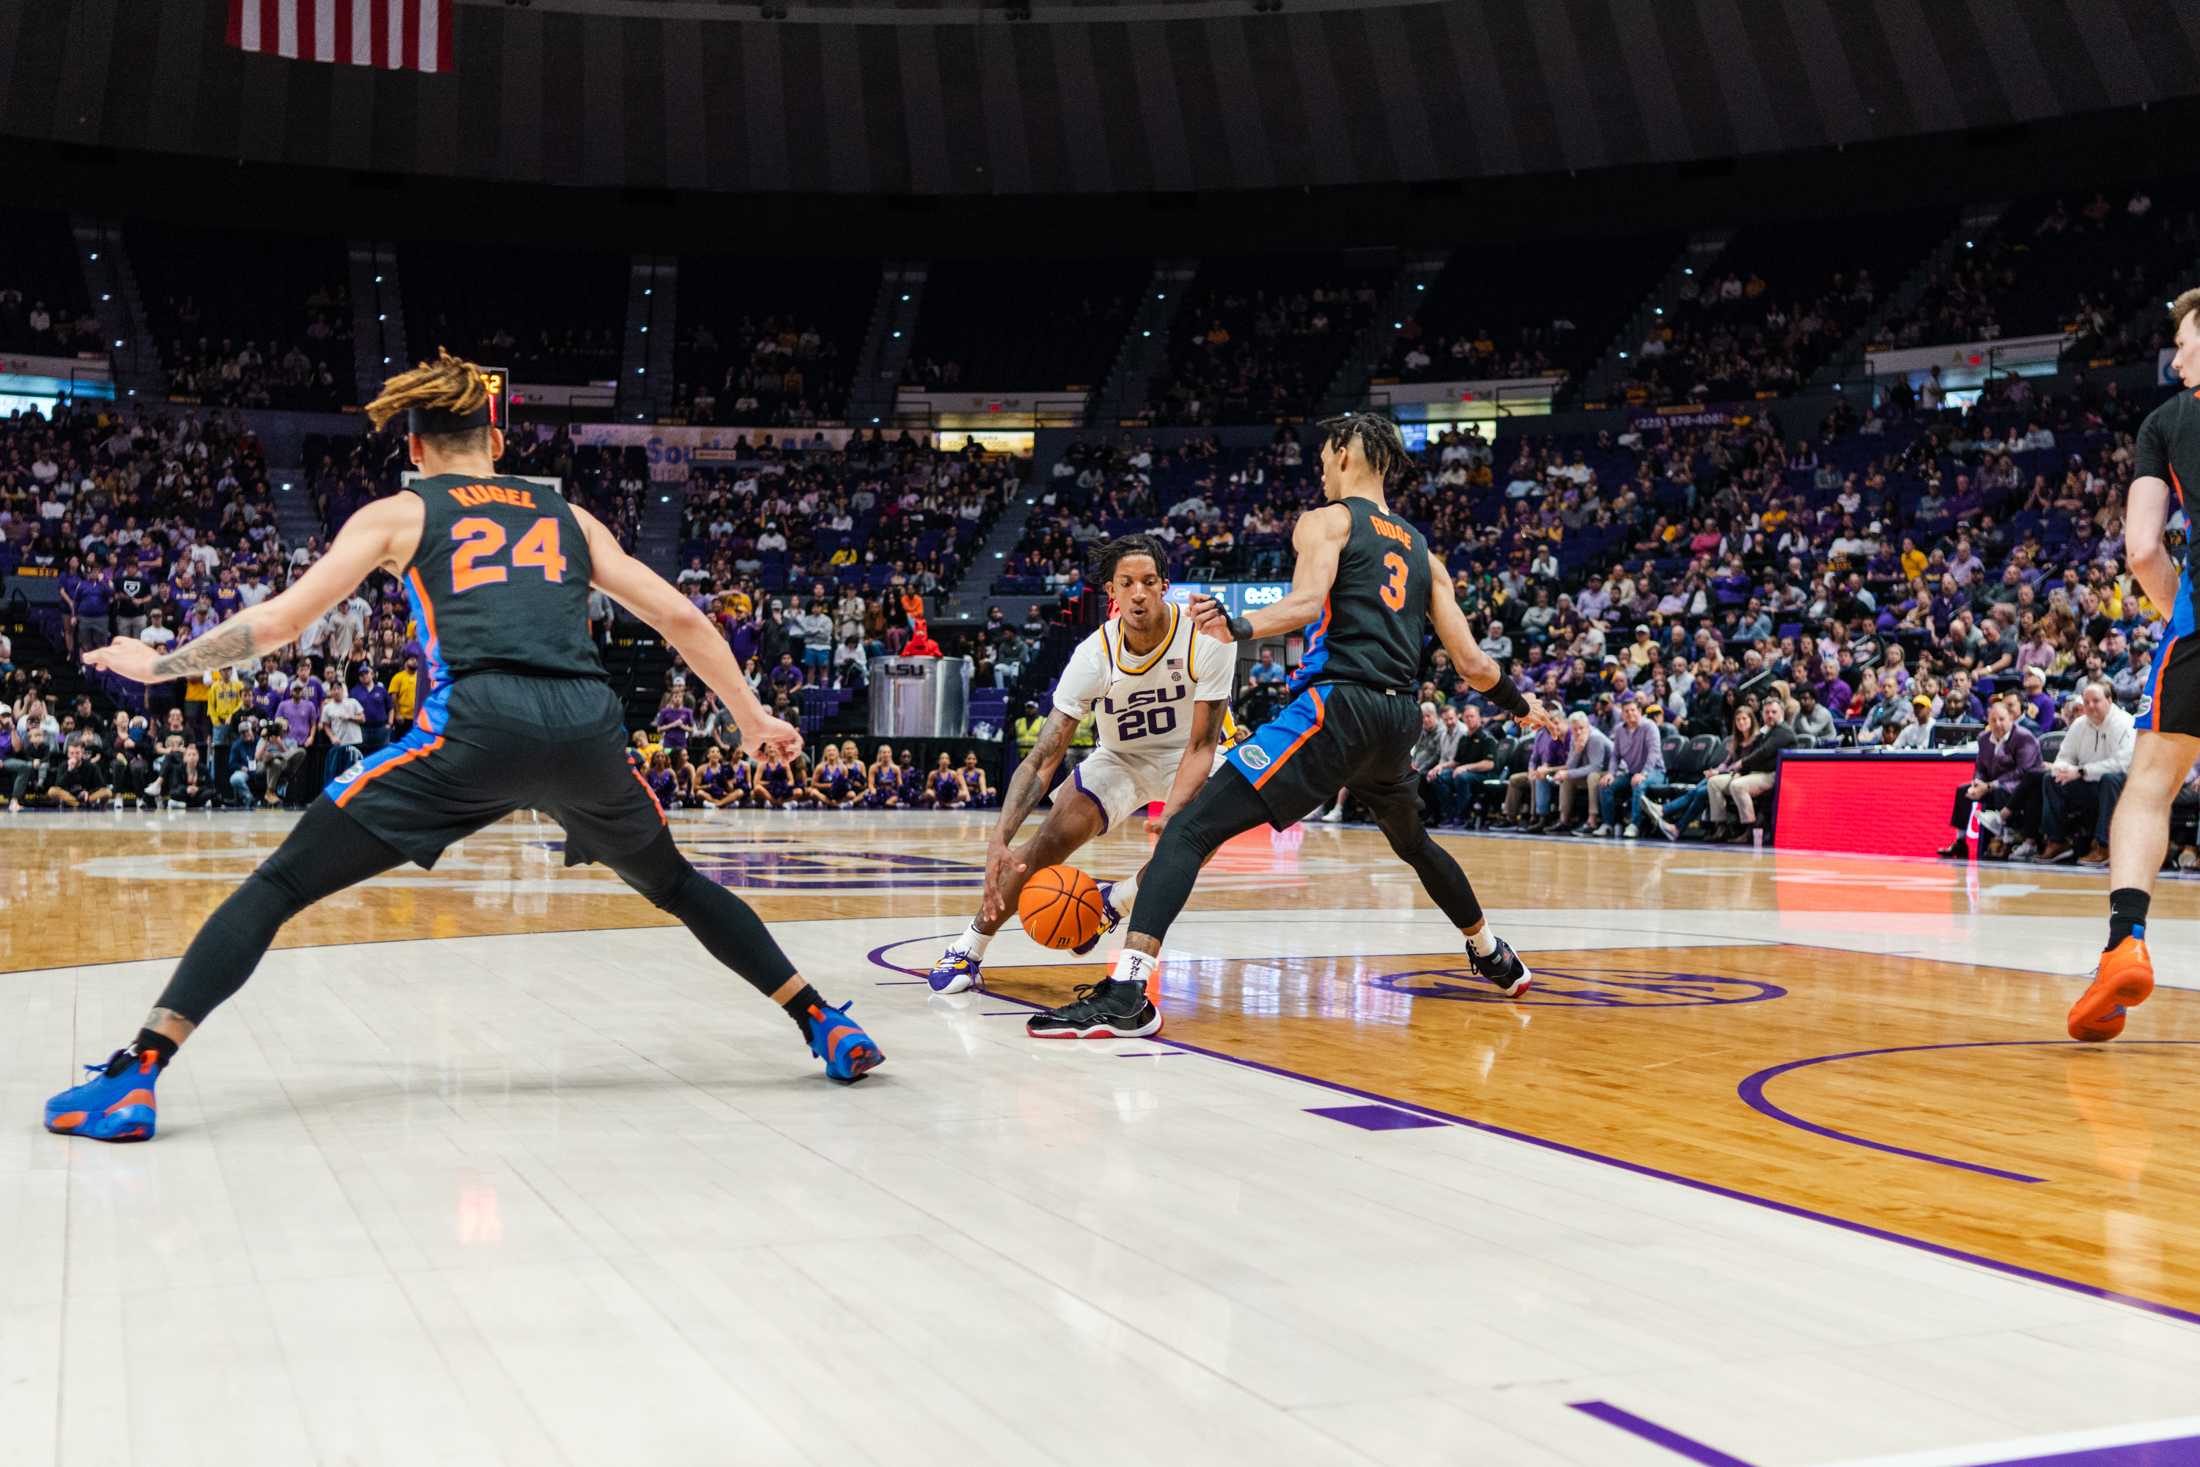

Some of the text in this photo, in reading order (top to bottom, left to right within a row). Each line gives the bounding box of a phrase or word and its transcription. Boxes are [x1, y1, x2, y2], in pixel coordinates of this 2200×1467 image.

[448, 484, 537, 510] KUGEL
[451, 517, 567, 594] 24
[1379, 551, 1409, 612] 3
[884, 663, 924, 677] LSU
[1104, 684, 1187, 715] LSU
[1117, 706, 1177, 741] 20
